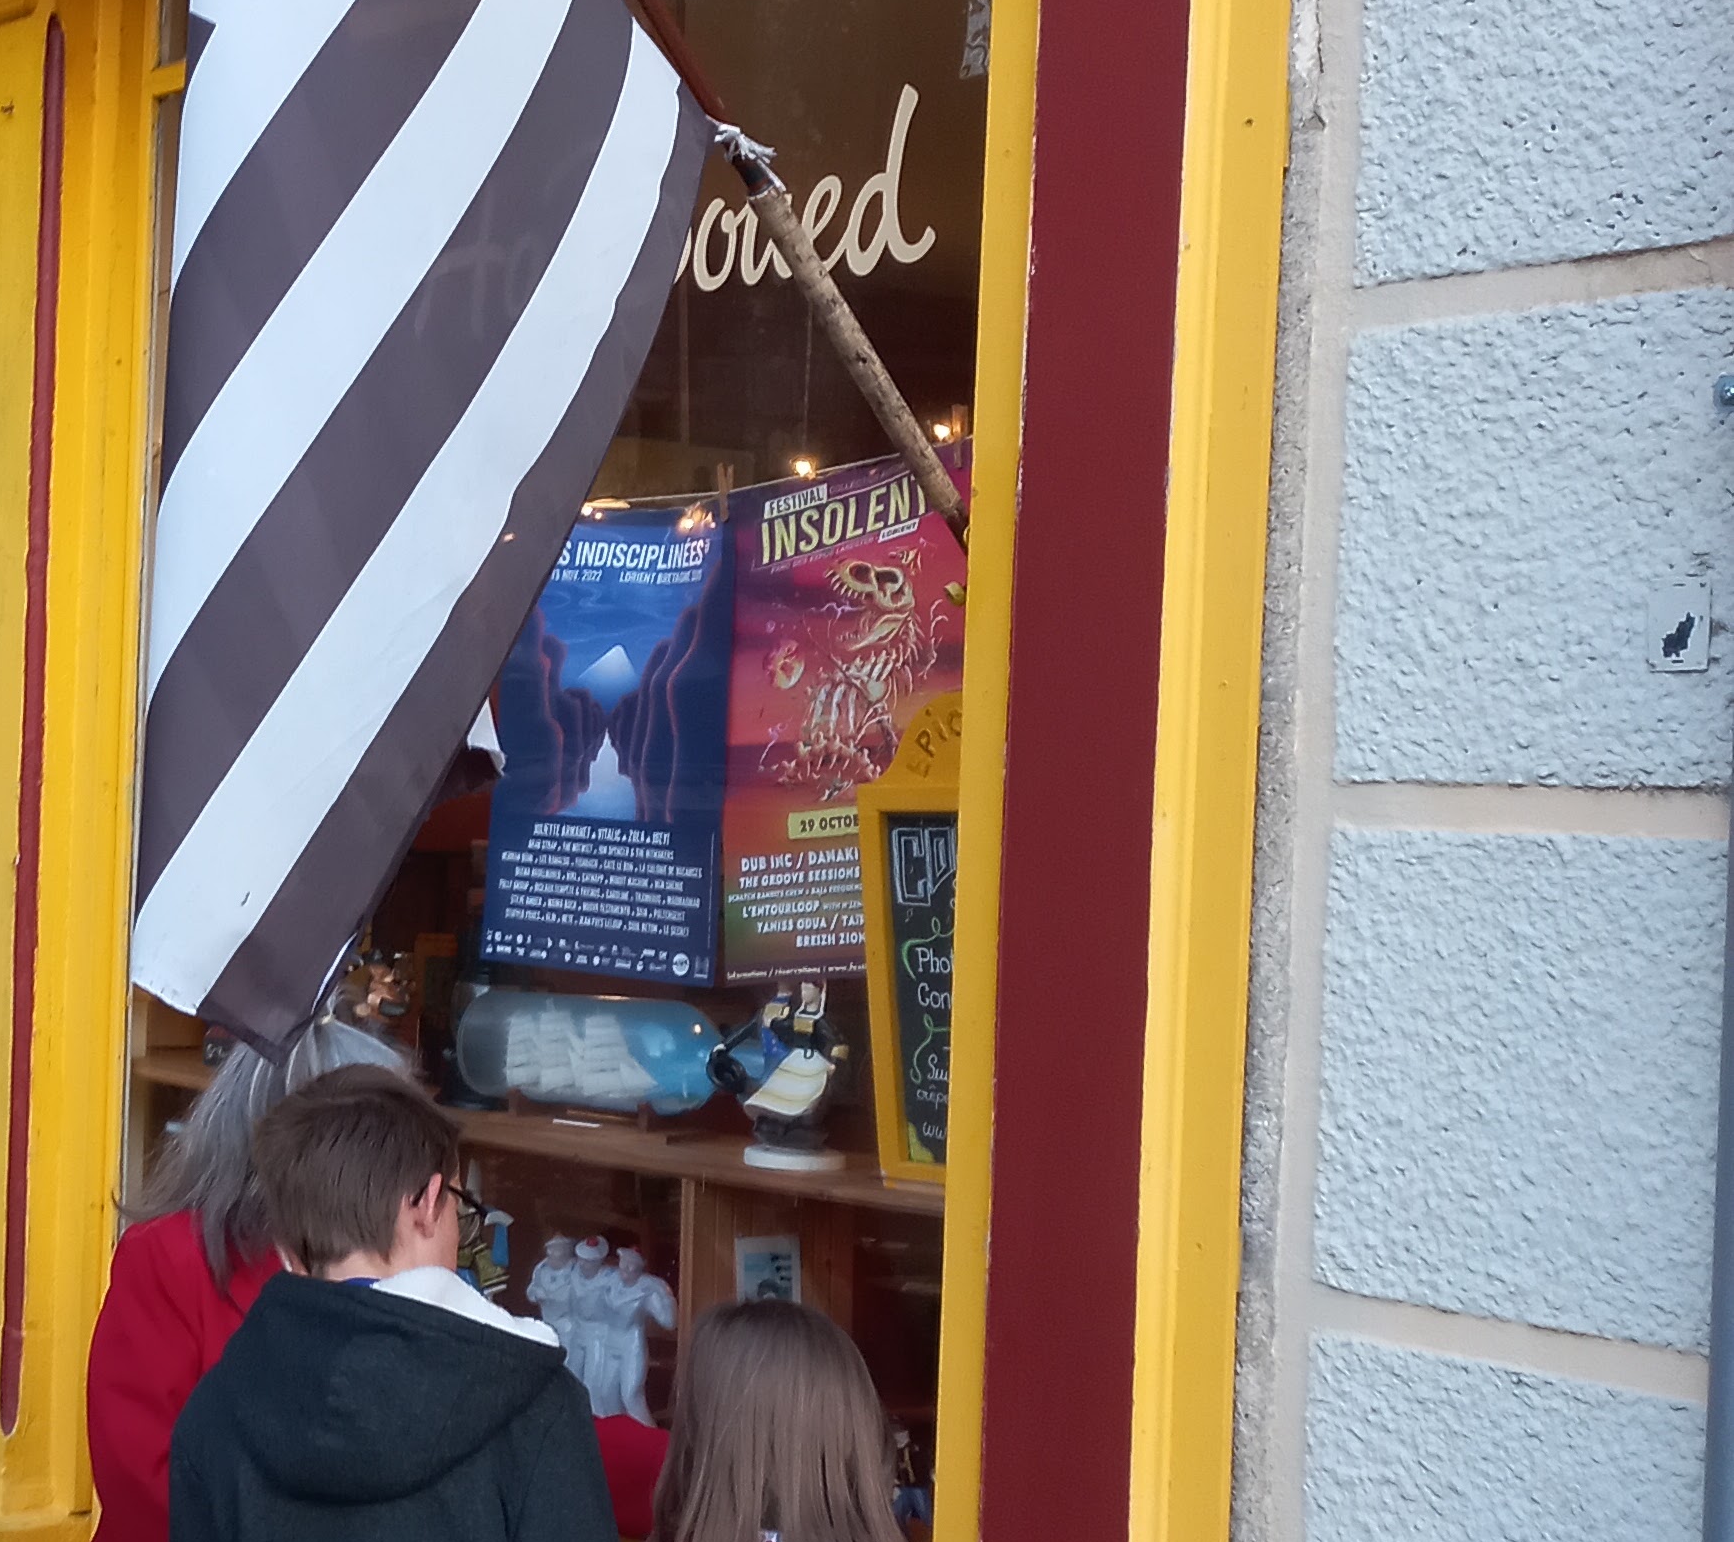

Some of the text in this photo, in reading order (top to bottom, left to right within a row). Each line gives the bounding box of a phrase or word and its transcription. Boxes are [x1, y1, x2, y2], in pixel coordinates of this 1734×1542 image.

[768, 489, 825, 516] FESTIVAL
[575, 538, 704, 570] INDISCIPLINÉES
[800, 818, 816, 833] 29
[741, 857, 767, 872] DUB
[739, 876, 758, 890] THE
[761, 870, 805, 887] GROOVE
